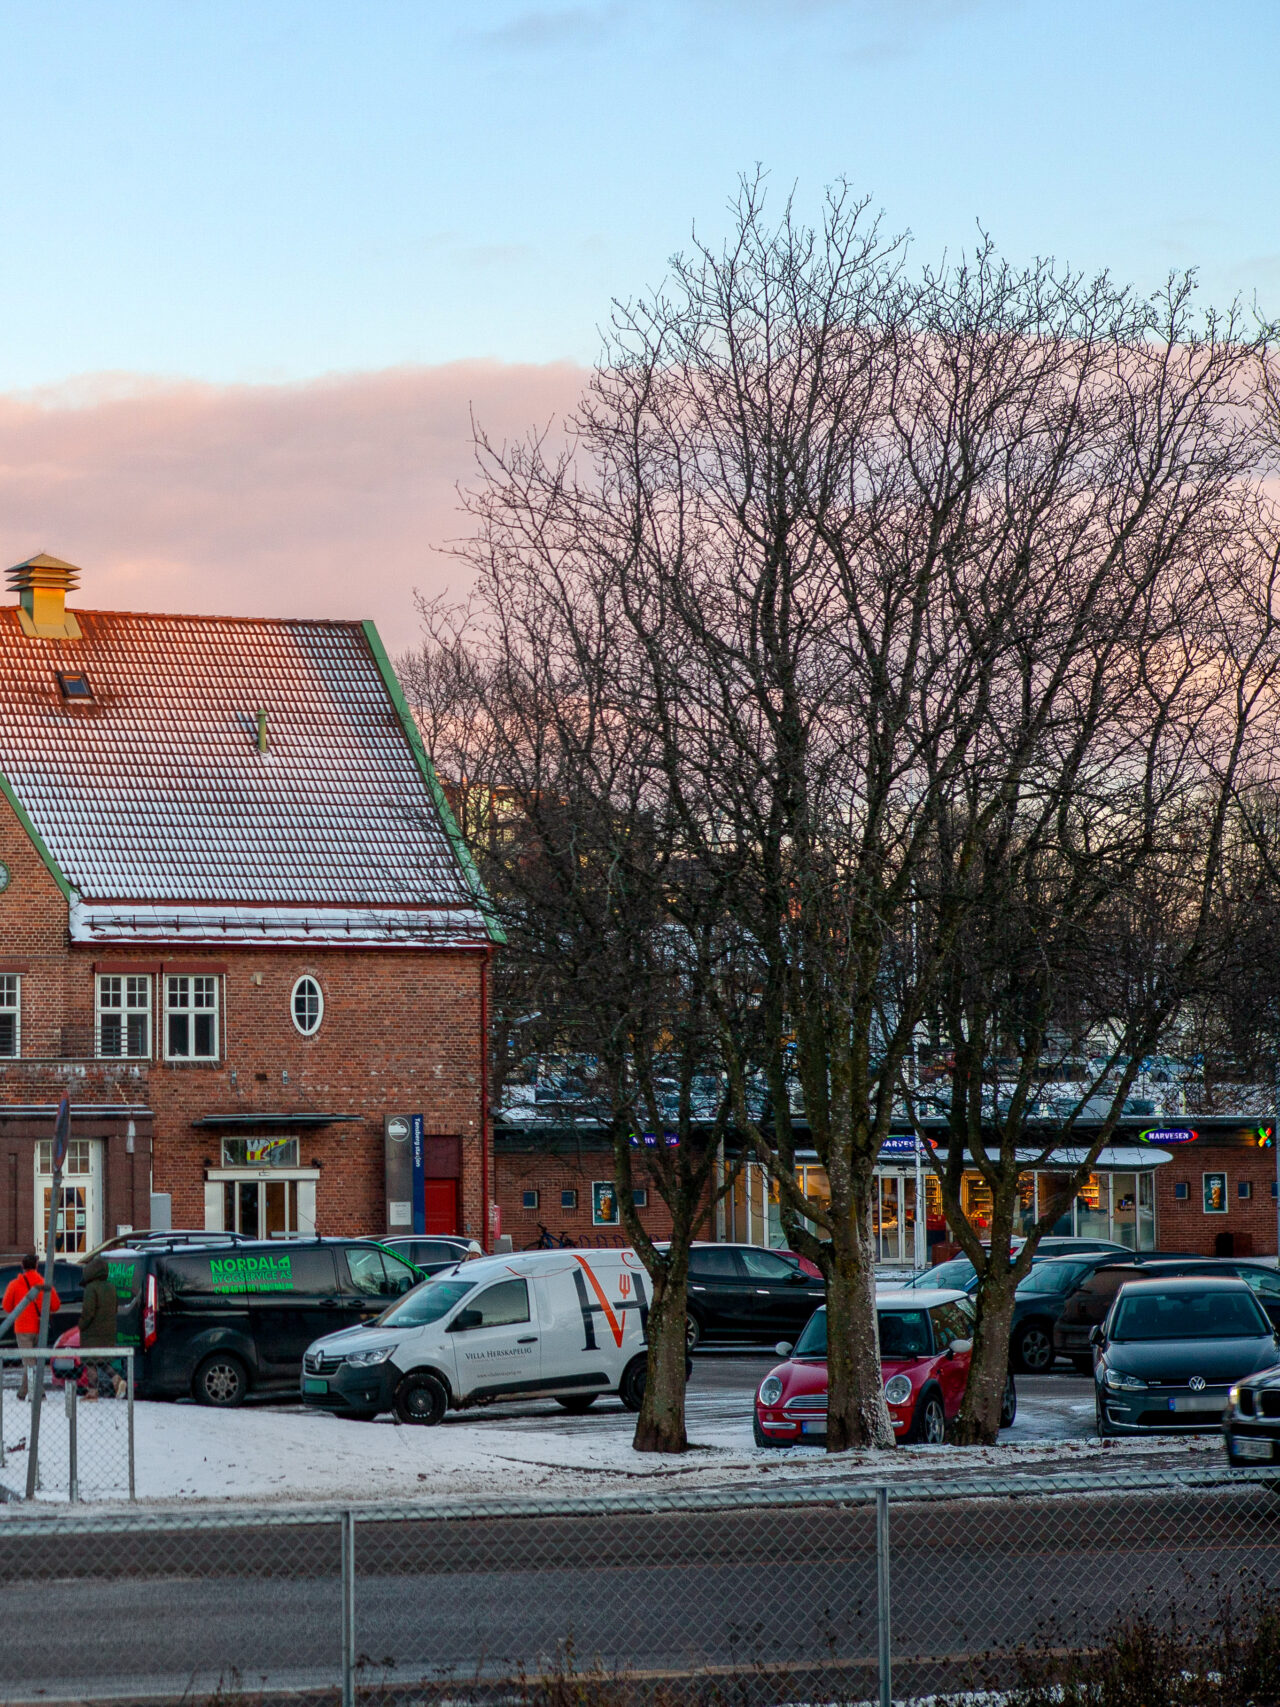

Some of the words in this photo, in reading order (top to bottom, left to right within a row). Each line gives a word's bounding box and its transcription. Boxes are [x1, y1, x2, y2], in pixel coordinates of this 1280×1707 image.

[1148, 1132, 1190, 1140] NARVESEN
[414, 1146, 422, 1168] stasjon
[209, 1255, 278, 1273] NORDAL
[212, 1270, 278, 1284] BYGGSERVICE
[280, 1270, 293, 1280] AS
